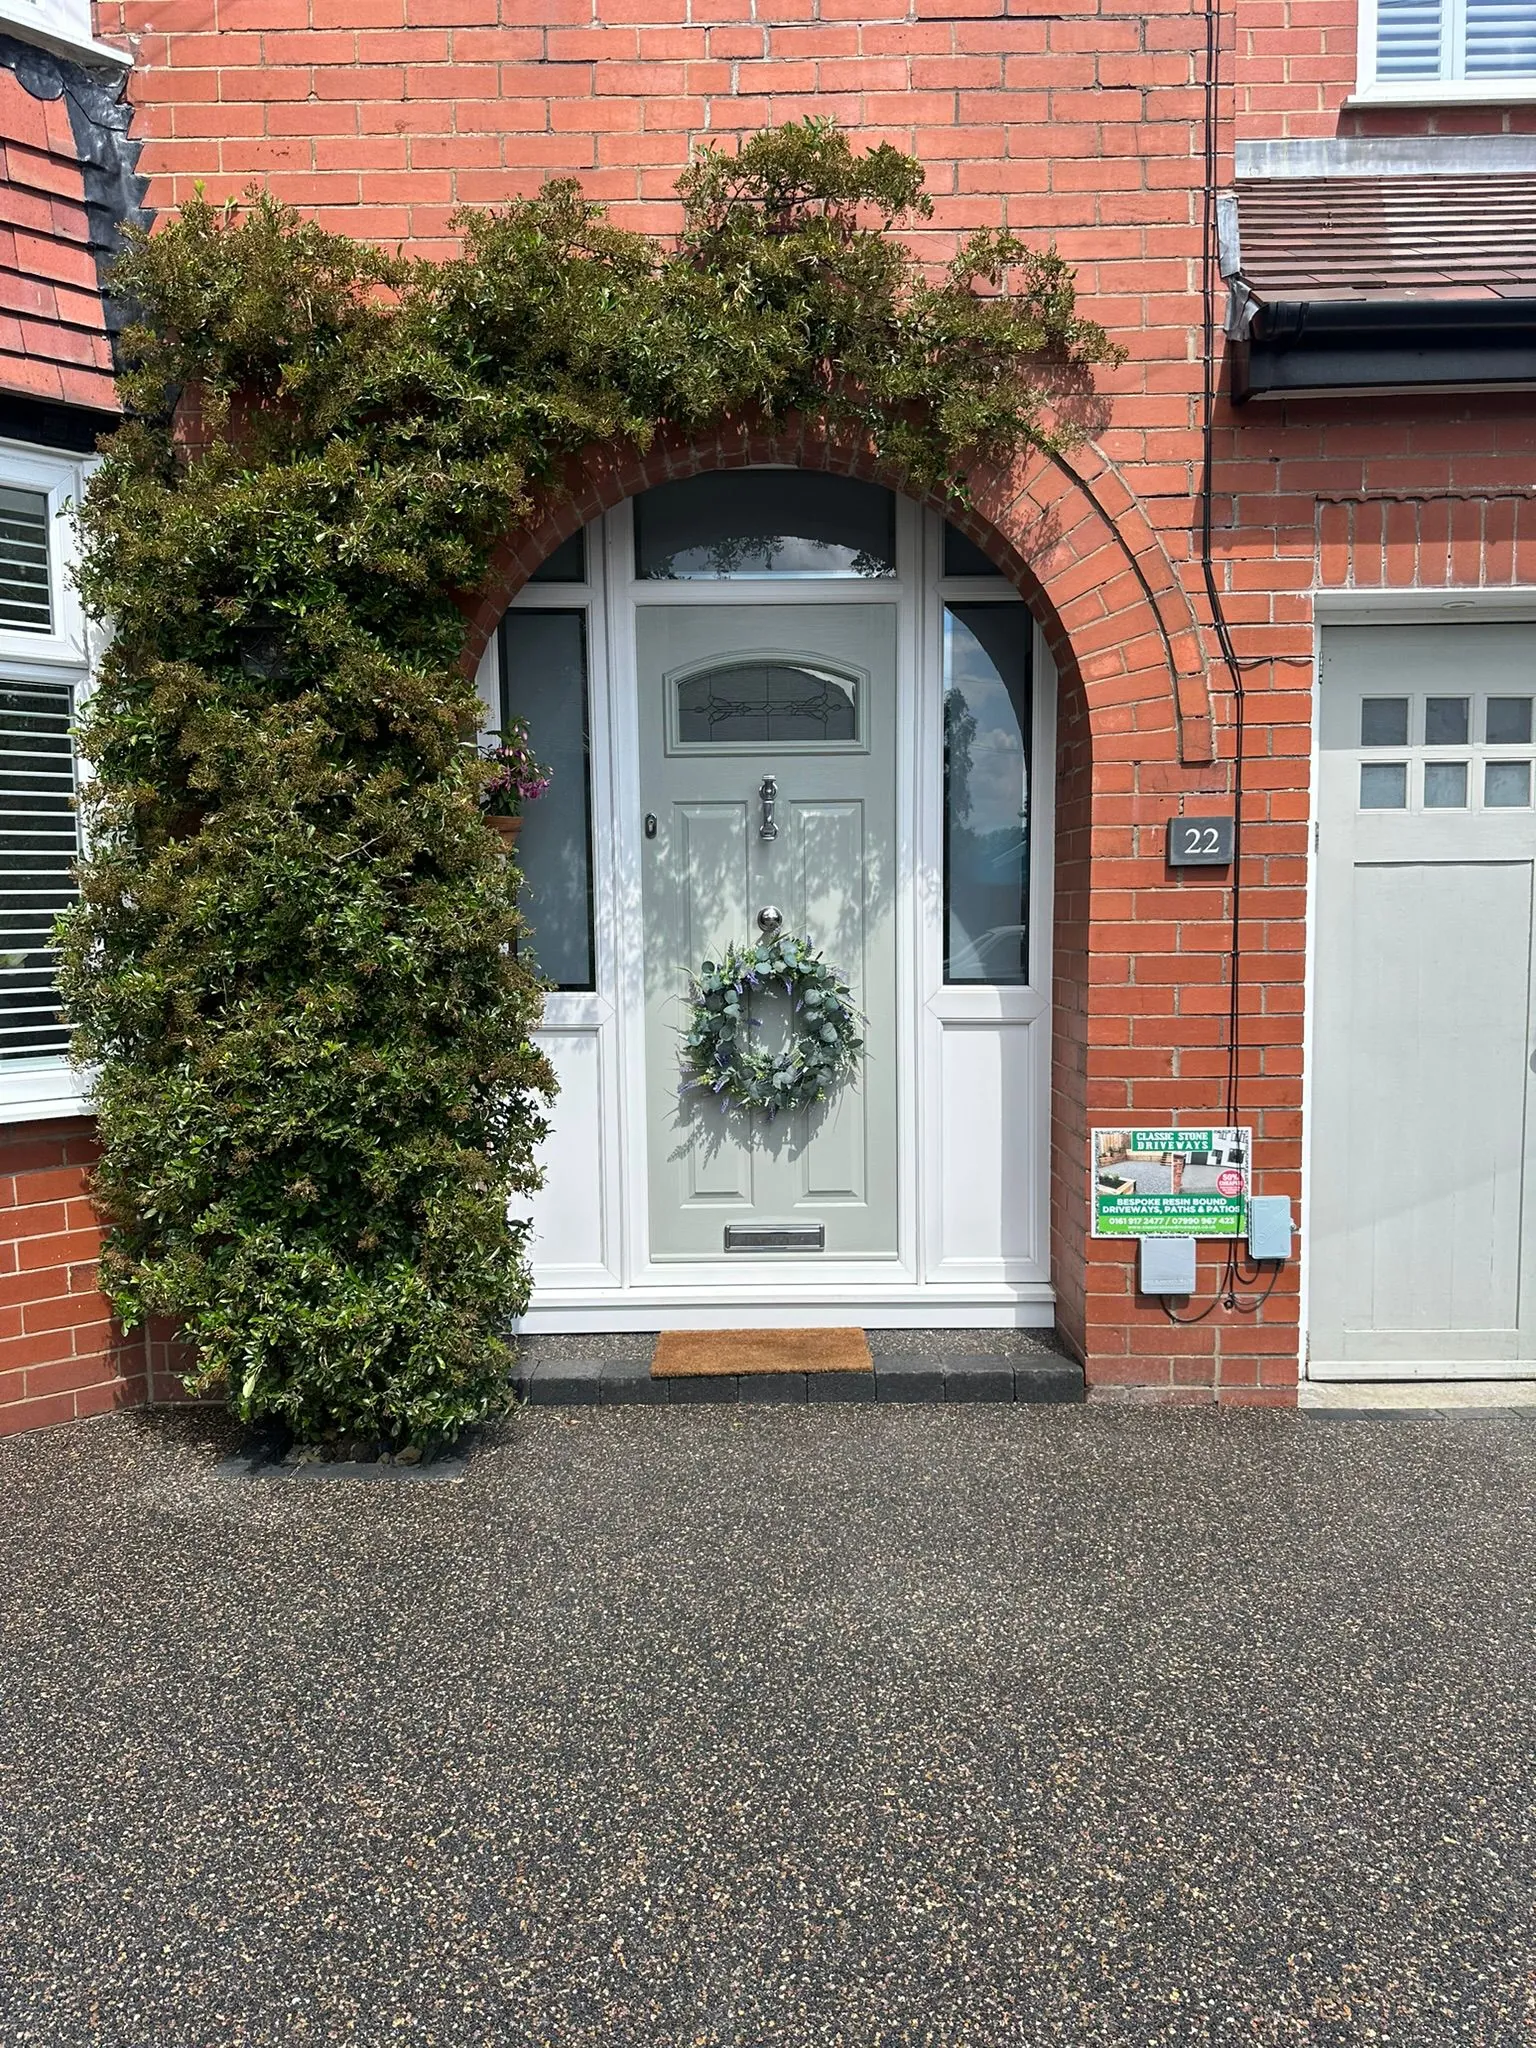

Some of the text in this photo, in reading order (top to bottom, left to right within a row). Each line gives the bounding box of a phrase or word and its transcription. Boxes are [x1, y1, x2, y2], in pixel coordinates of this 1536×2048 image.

[1184, 828, 1220, 854] 22
[1136, 1132, 1208, 1141] CLASSIC STONE
[1137, 1141, 1209, 1150] DRIVEWAYS
[1103, 1206, 1162, 1214] DRIVEWAYS,
[1109, 1217, 1127, 1225] 0161
[1128, 1217, 1143, 1225] 917
[1144, 1217, 1164, 1225] 2477
